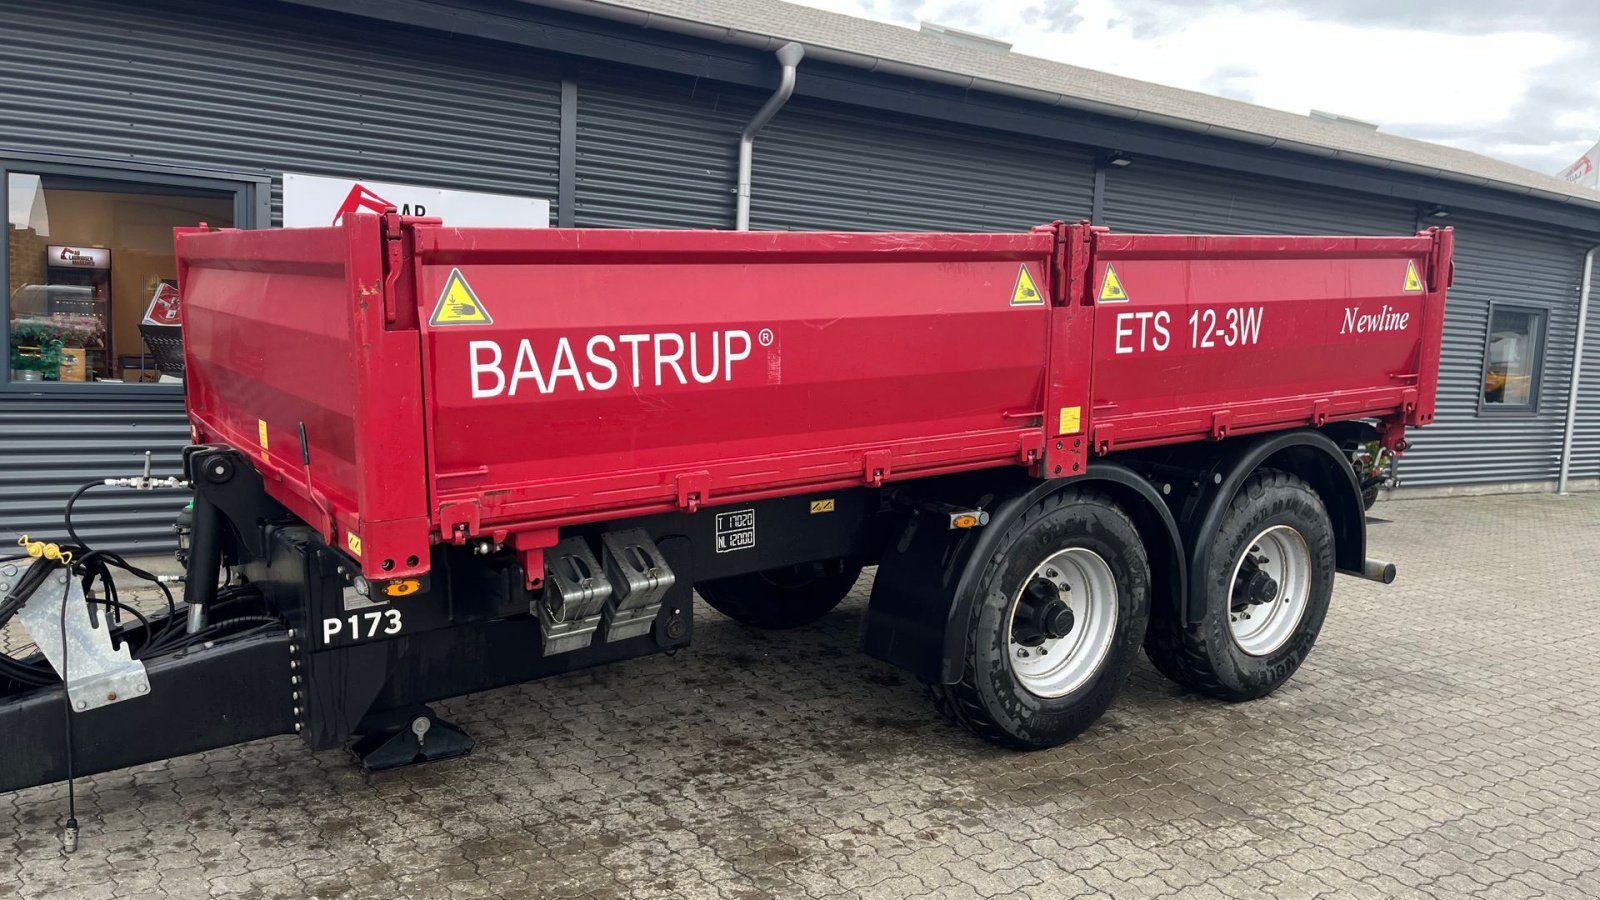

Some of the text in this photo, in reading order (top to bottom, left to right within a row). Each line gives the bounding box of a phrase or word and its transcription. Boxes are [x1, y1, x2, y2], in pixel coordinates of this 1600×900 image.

[1115, 306, 1264, 354] ETS 12-3W
[1340, 304, 1410, 334] Newline
[469, 329, 752, 399] BAASTRUP
[718, 513, 753, 530] T 17020
[718, 531, 753, 549] NL 12000
[323, 608, 402, 644] P173
